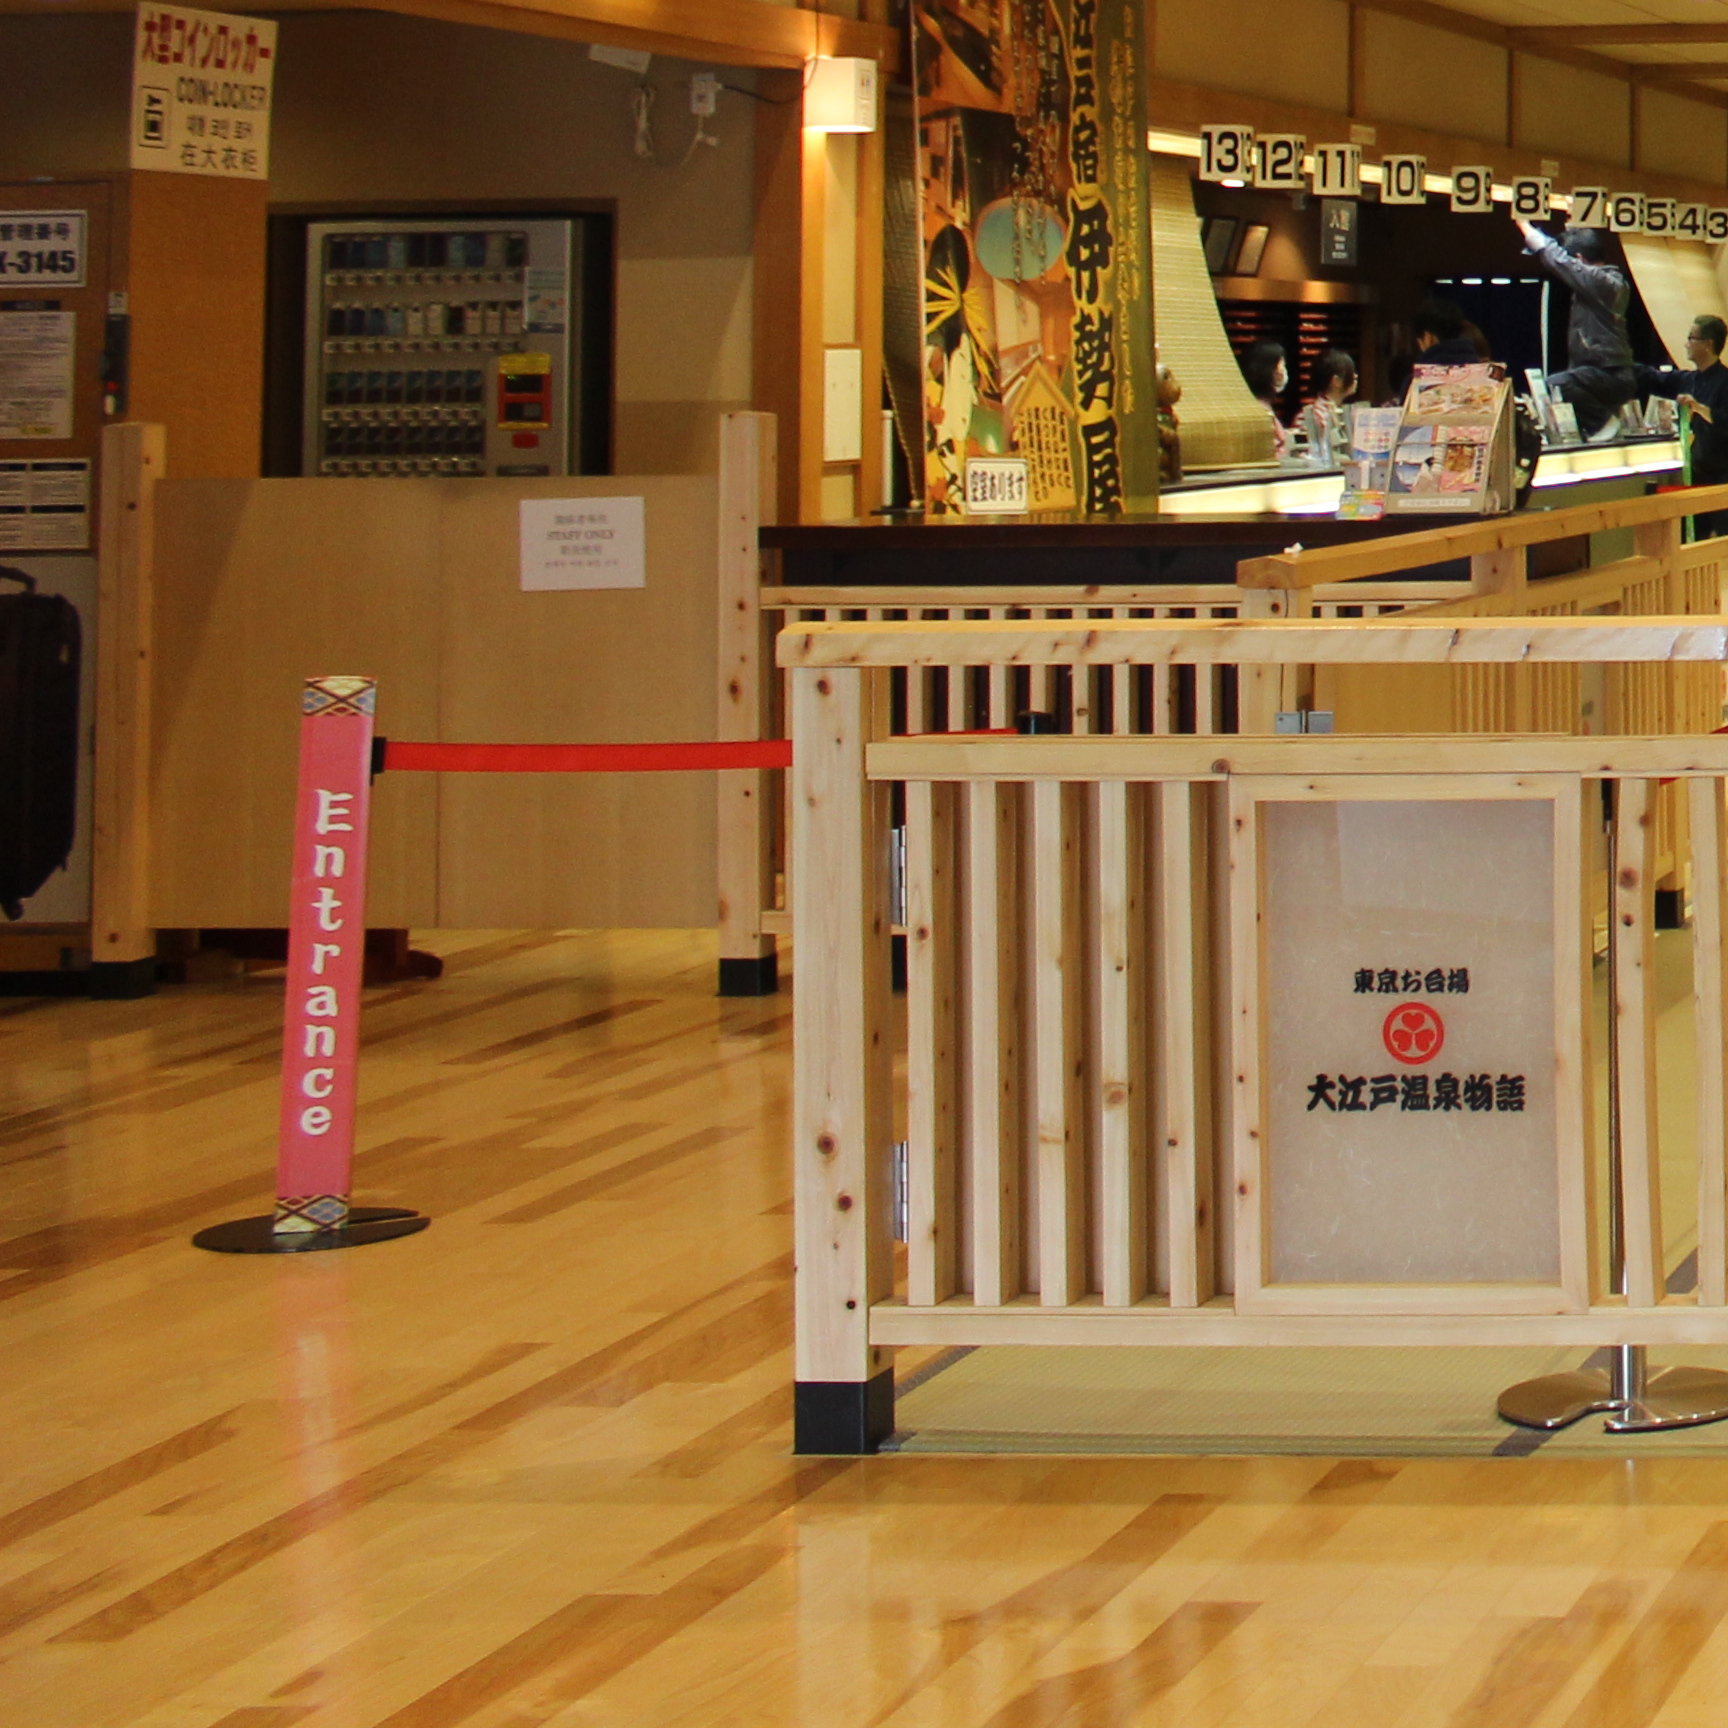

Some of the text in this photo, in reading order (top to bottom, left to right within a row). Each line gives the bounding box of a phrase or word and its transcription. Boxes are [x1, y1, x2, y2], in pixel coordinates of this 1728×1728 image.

[142, 12, 271, 74] 大型コインロッカー
[1202, 131, 1239, 174] 13
[1256, 140, 1293, 181] 12
[1317, 150, 1346, 188] 11
[1382, 160, 1415, 197] 10
[1455, 171, 1480, 206] 9
[1515, 181, 1540, 214] 8
[1575, 191, 1598, 222] 7
[1614, 197, 1637, 227] 6
[1646, 202, 1667, 231] 5
[1678, 207, 1700, 236] 4
[1708, 211, 1728, 239] 3
[301, 788, 354, 1136] Entrance
[1353, 967, 1470, 994] 東京お台場
[1306, 1073, 1527, 1112] 大江戸温泉物語
